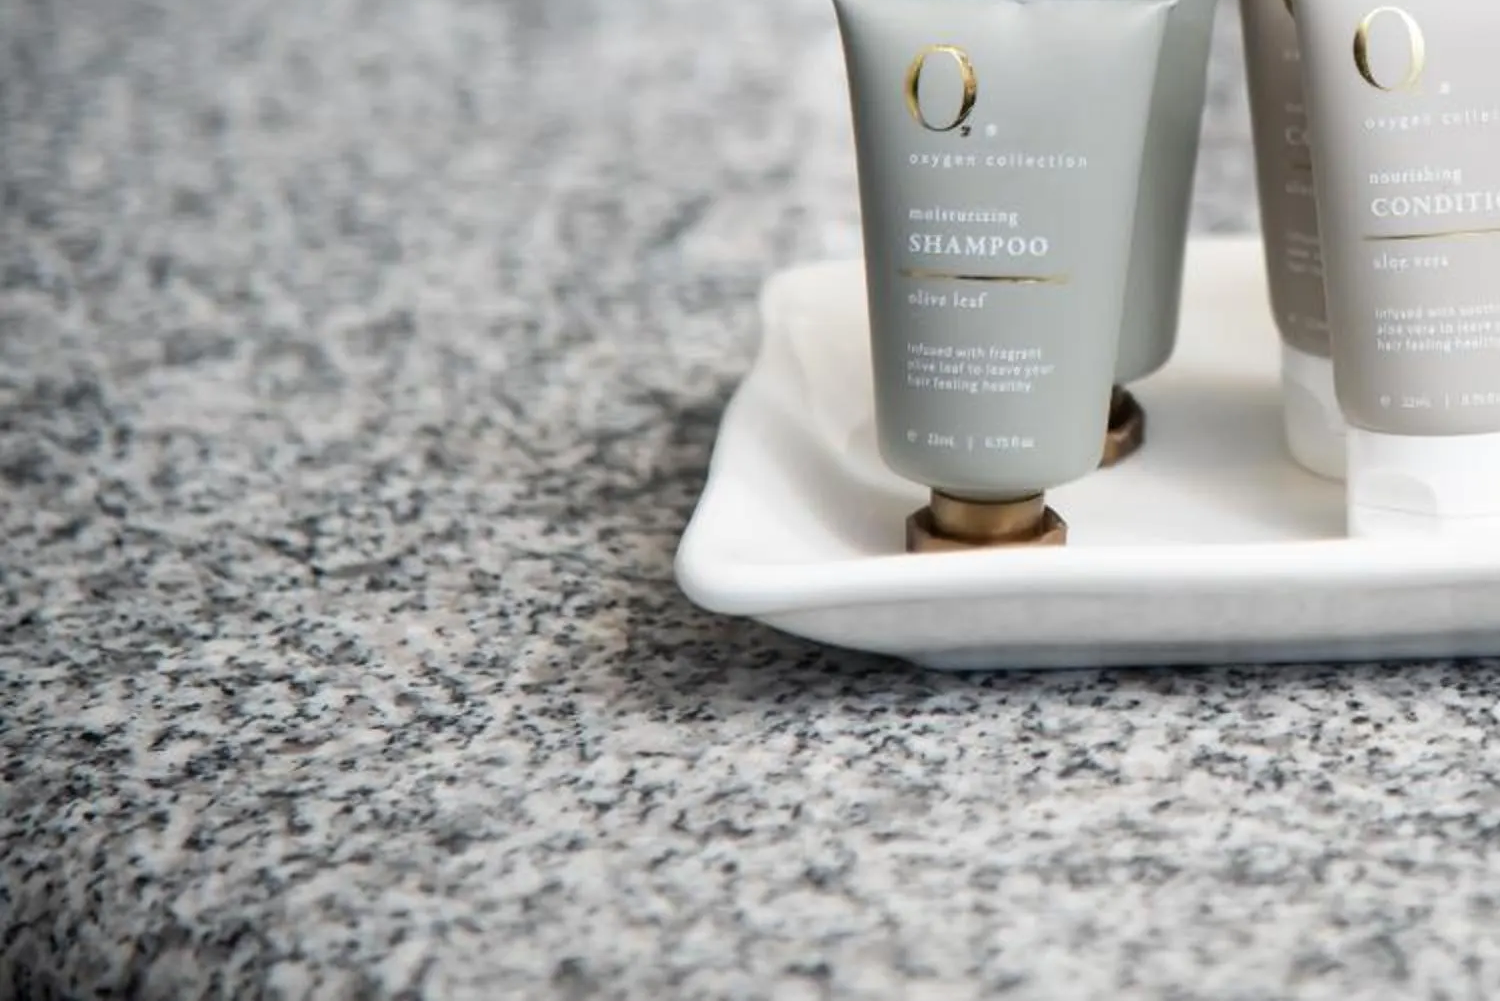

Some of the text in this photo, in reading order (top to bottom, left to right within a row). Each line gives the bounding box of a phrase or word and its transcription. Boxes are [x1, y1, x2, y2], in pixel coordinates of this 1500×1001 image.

[1364, 112, 1431, 131] oxygen
[908, 153, 1088, 168] oxygen collection
[1369, 164, 1462, 186] nourishing
[908, 205, 1019, 228] moisturizing
[908, 232, 1050, 257] SHAMPOO
[1372, 251, 1449, 270] aloe vera
[908, 288, 989, 309] olive leaf
[955, 344, 986, 360] with
[939, 360, 964, 375] leaf
[967, 363, 983, 376] to
[933, 376, 979, 394] feeling
